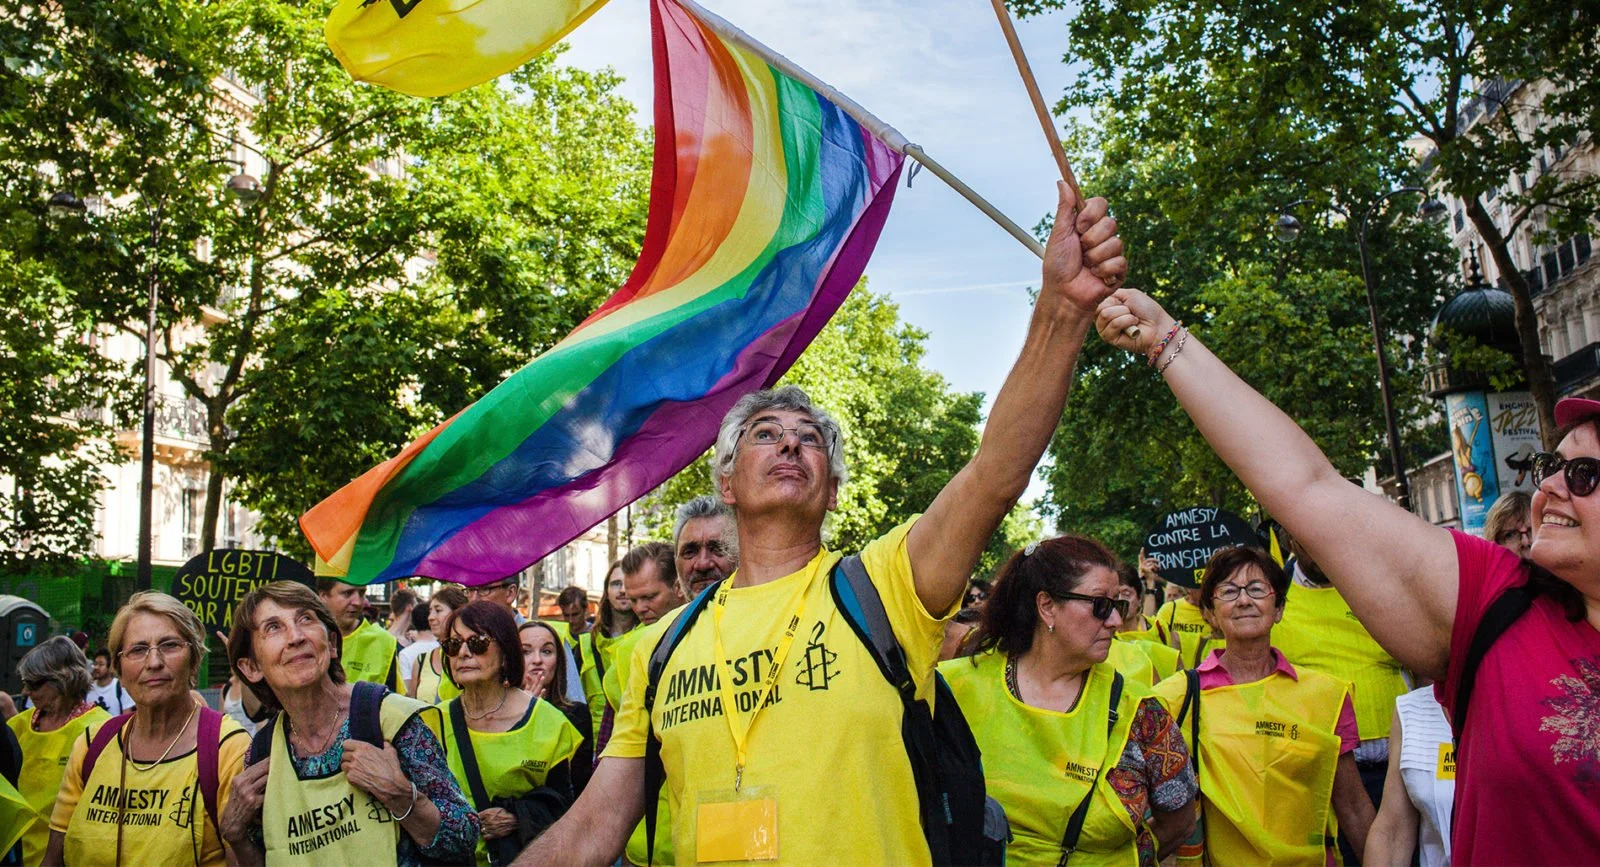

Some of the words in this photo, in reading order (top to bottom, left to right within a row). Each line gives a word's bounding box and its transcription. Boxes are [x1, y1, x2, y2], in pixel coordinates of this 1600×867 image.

[1492, 406, 1537, 432] JAZZ
[1166, 508, 1219, 528] AMNESTY
[1148, 528, 1201, 547] CONTRE
[1210, 524, 1230, 538] LA
[207, 551, 279, 579] LGBTI
[1148, 542, 1245, 570] TRANSPH
[661, 684, 783, 731] INTERNAIONAL
[1255, 721, 1286, 731] AMNESTY
